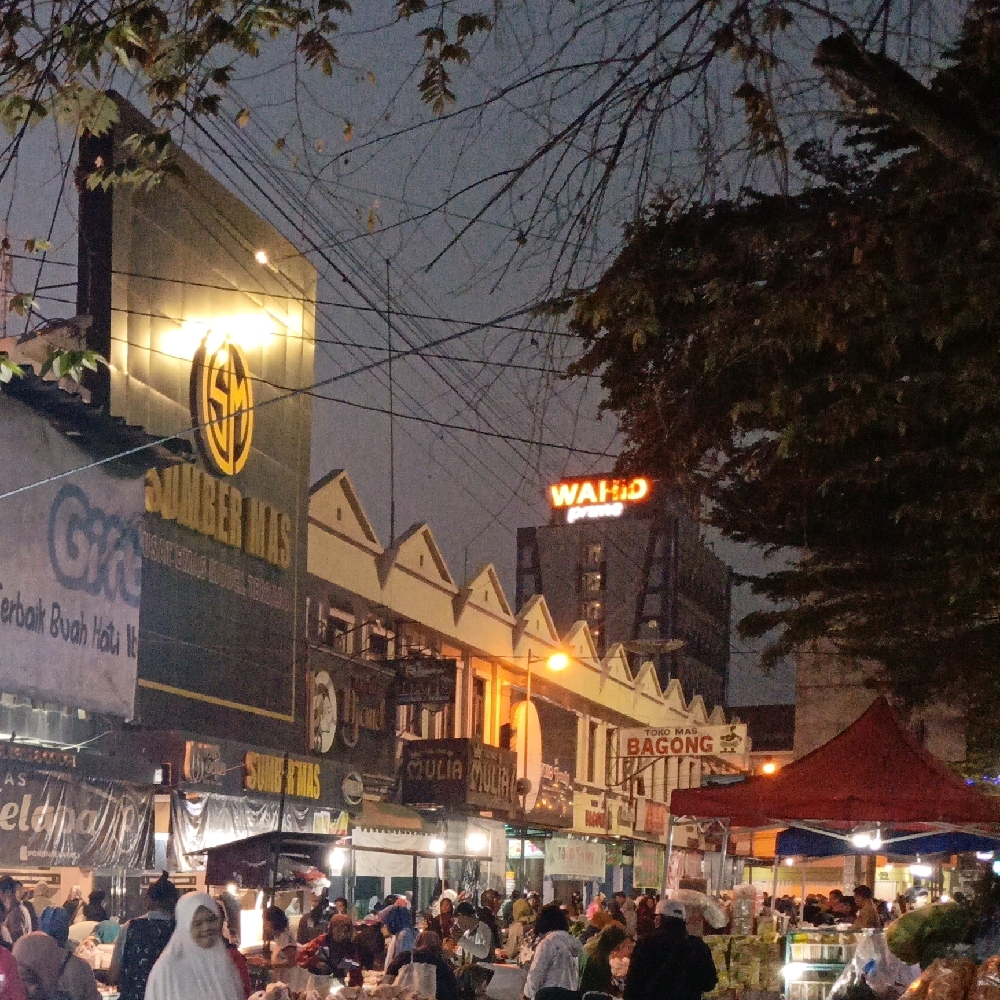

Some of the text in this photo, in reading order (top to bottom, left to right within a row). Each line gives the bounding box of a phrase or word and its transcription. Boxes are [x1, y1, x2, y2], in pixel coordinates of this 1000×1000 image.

[50, 602, 88, 646] Buah
[92, 614, 120, 656] Hati
[626, 735, 714, 757] BAGONG
[644, 727, 699, 738] TOKO MAS
[244, 751, 295, 796] SUMBR
